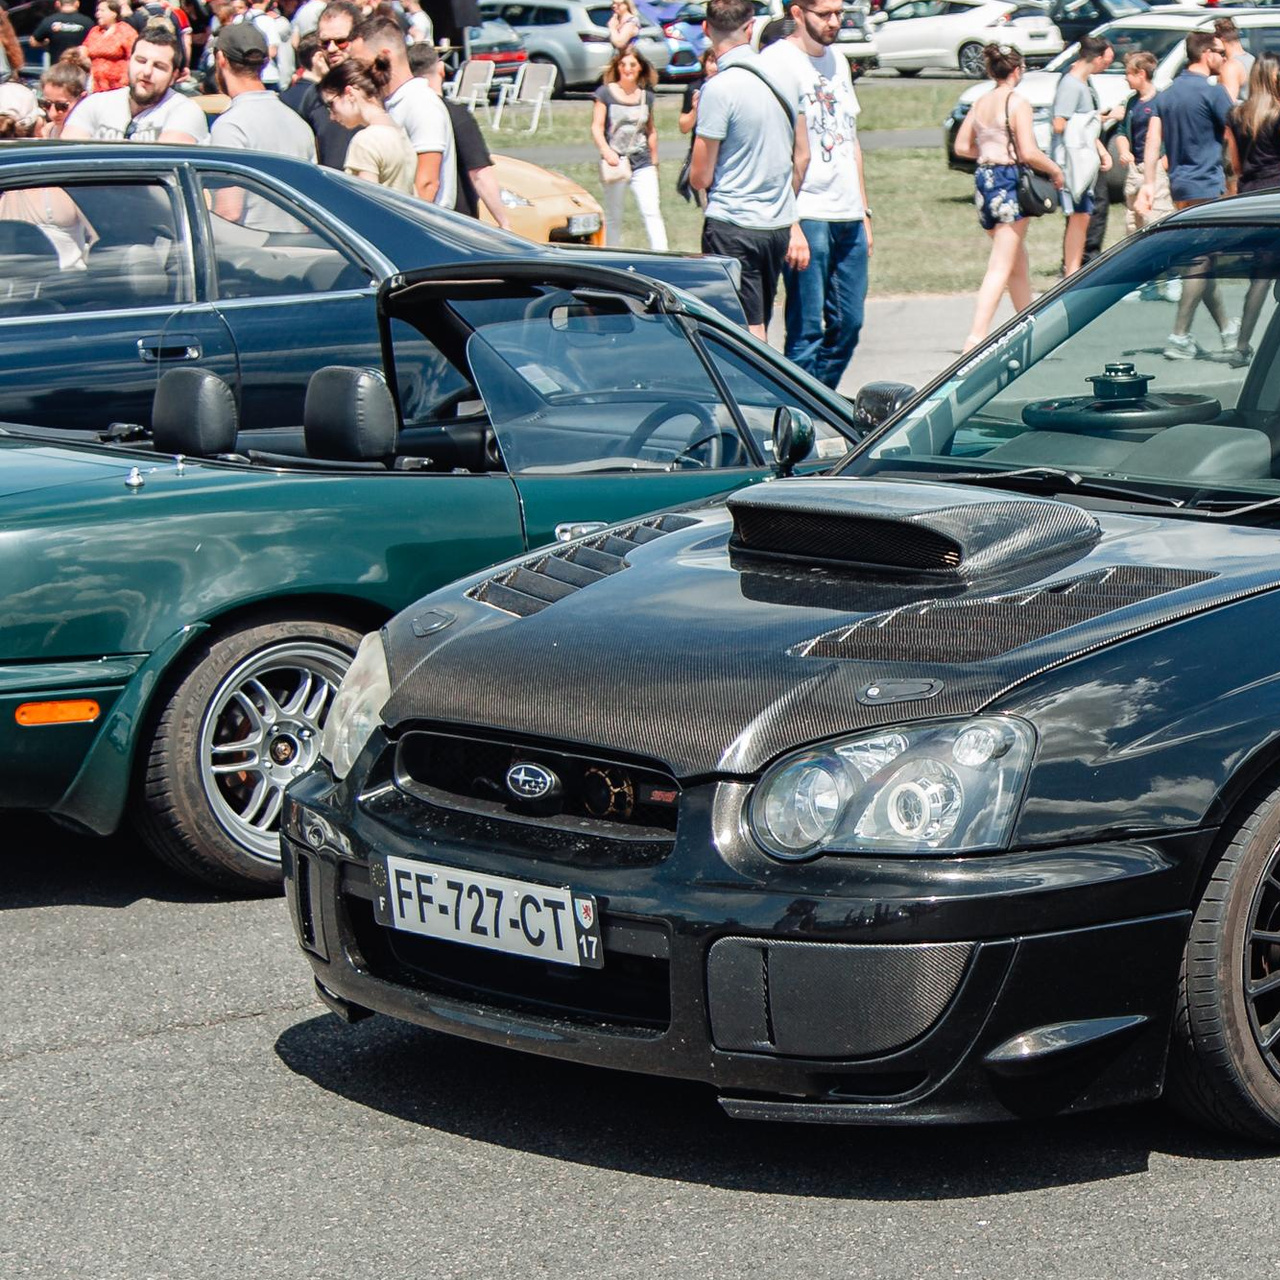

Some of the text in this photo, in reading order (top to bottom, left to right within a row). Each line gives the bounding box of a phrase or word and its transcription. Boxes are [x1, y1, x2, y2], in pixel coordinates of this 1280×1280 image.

[379, 869, 598, 959] F FF-727-CT 17
